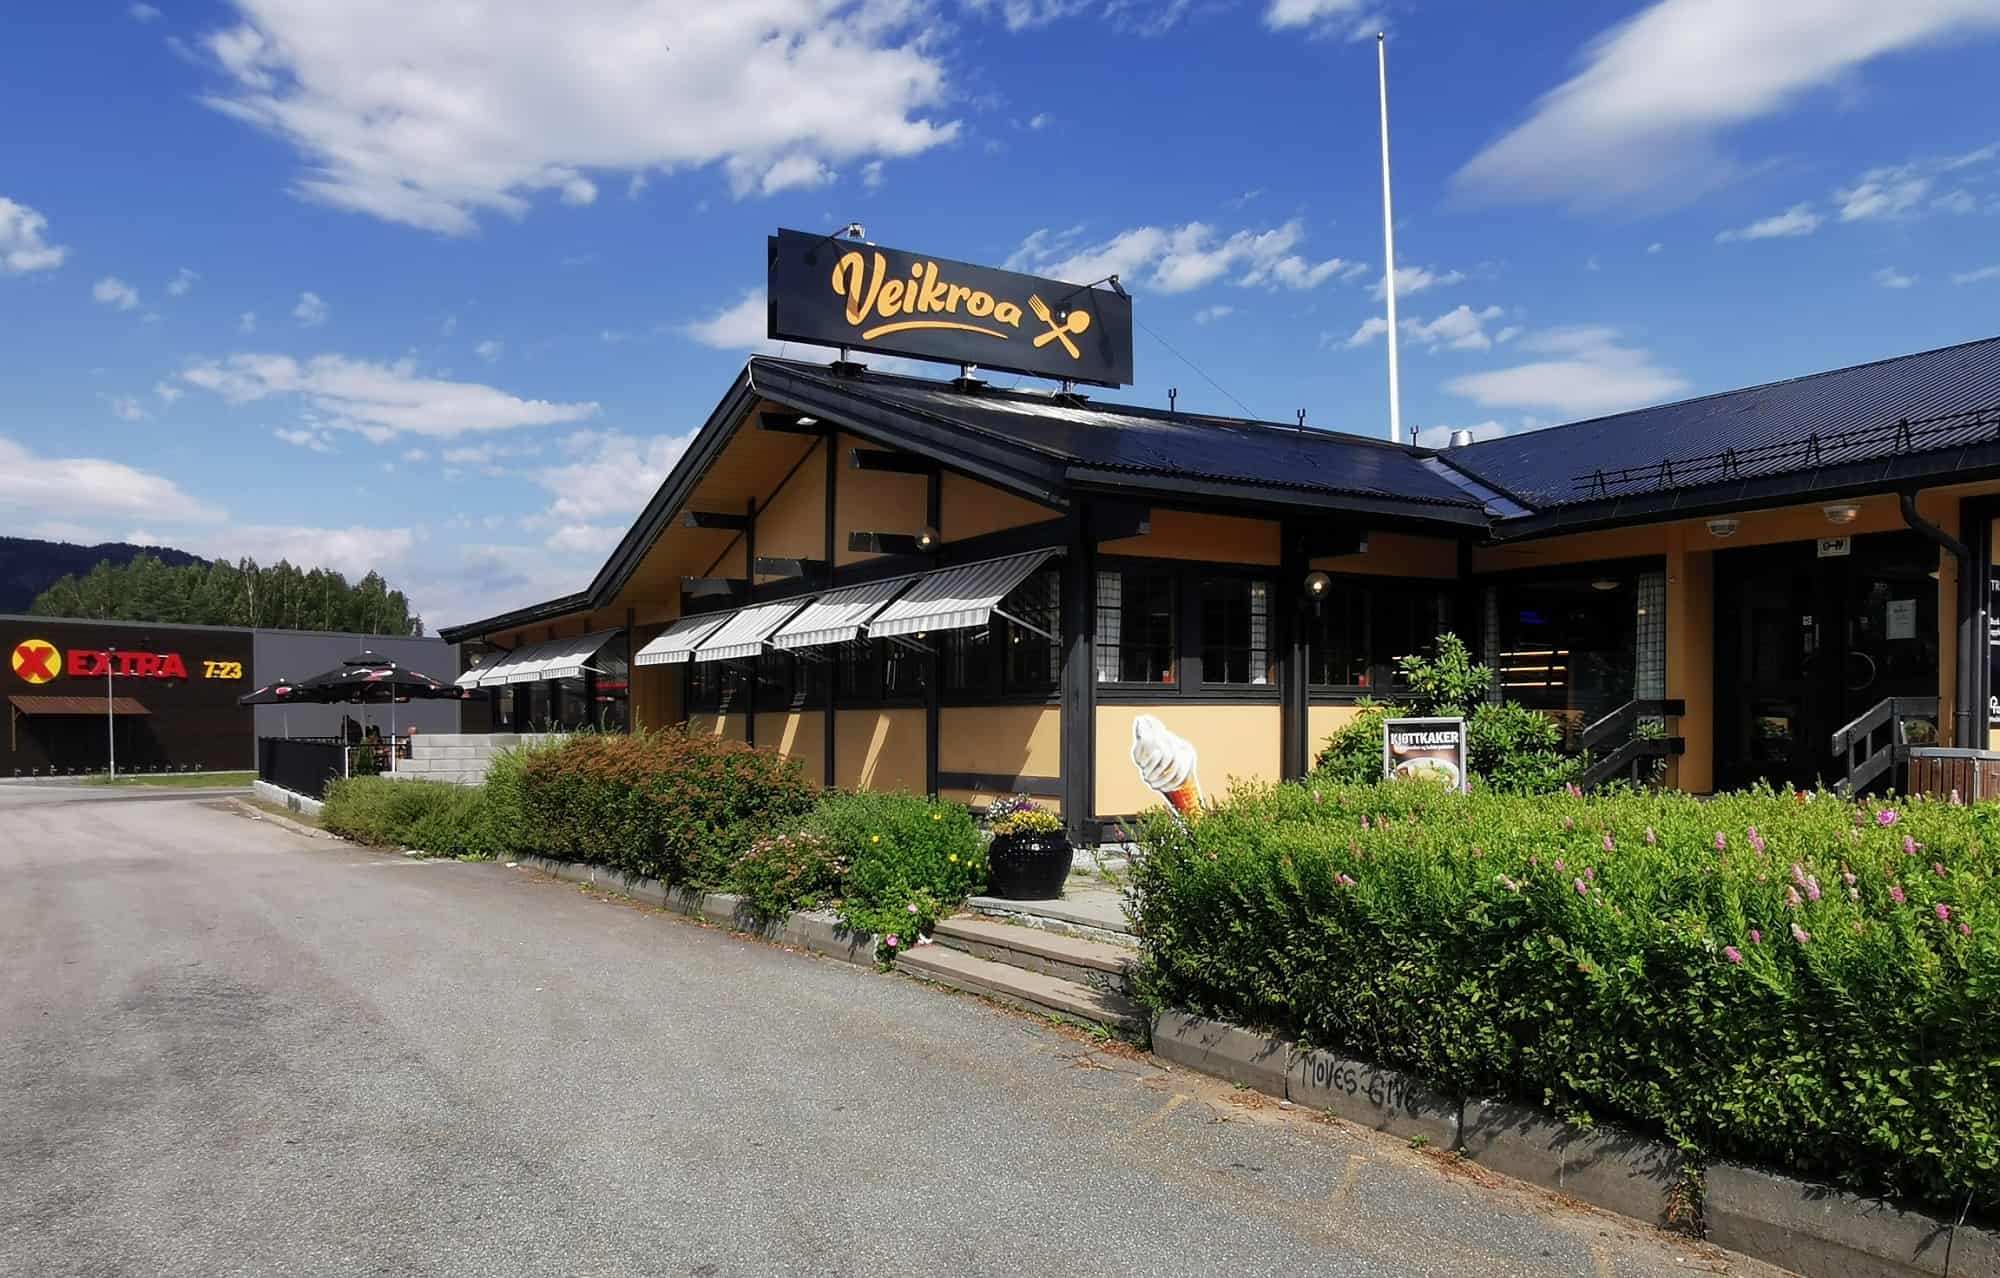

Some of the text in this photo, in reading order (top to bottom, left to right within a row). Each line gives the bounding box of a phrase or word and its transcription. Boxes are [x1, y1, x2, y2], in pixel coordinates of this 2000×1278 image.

[831, 250, 1023, 328] Veikroa
[67, 650, 188, 679] EXTRA
[203, 660, 243, 680] 7-23
